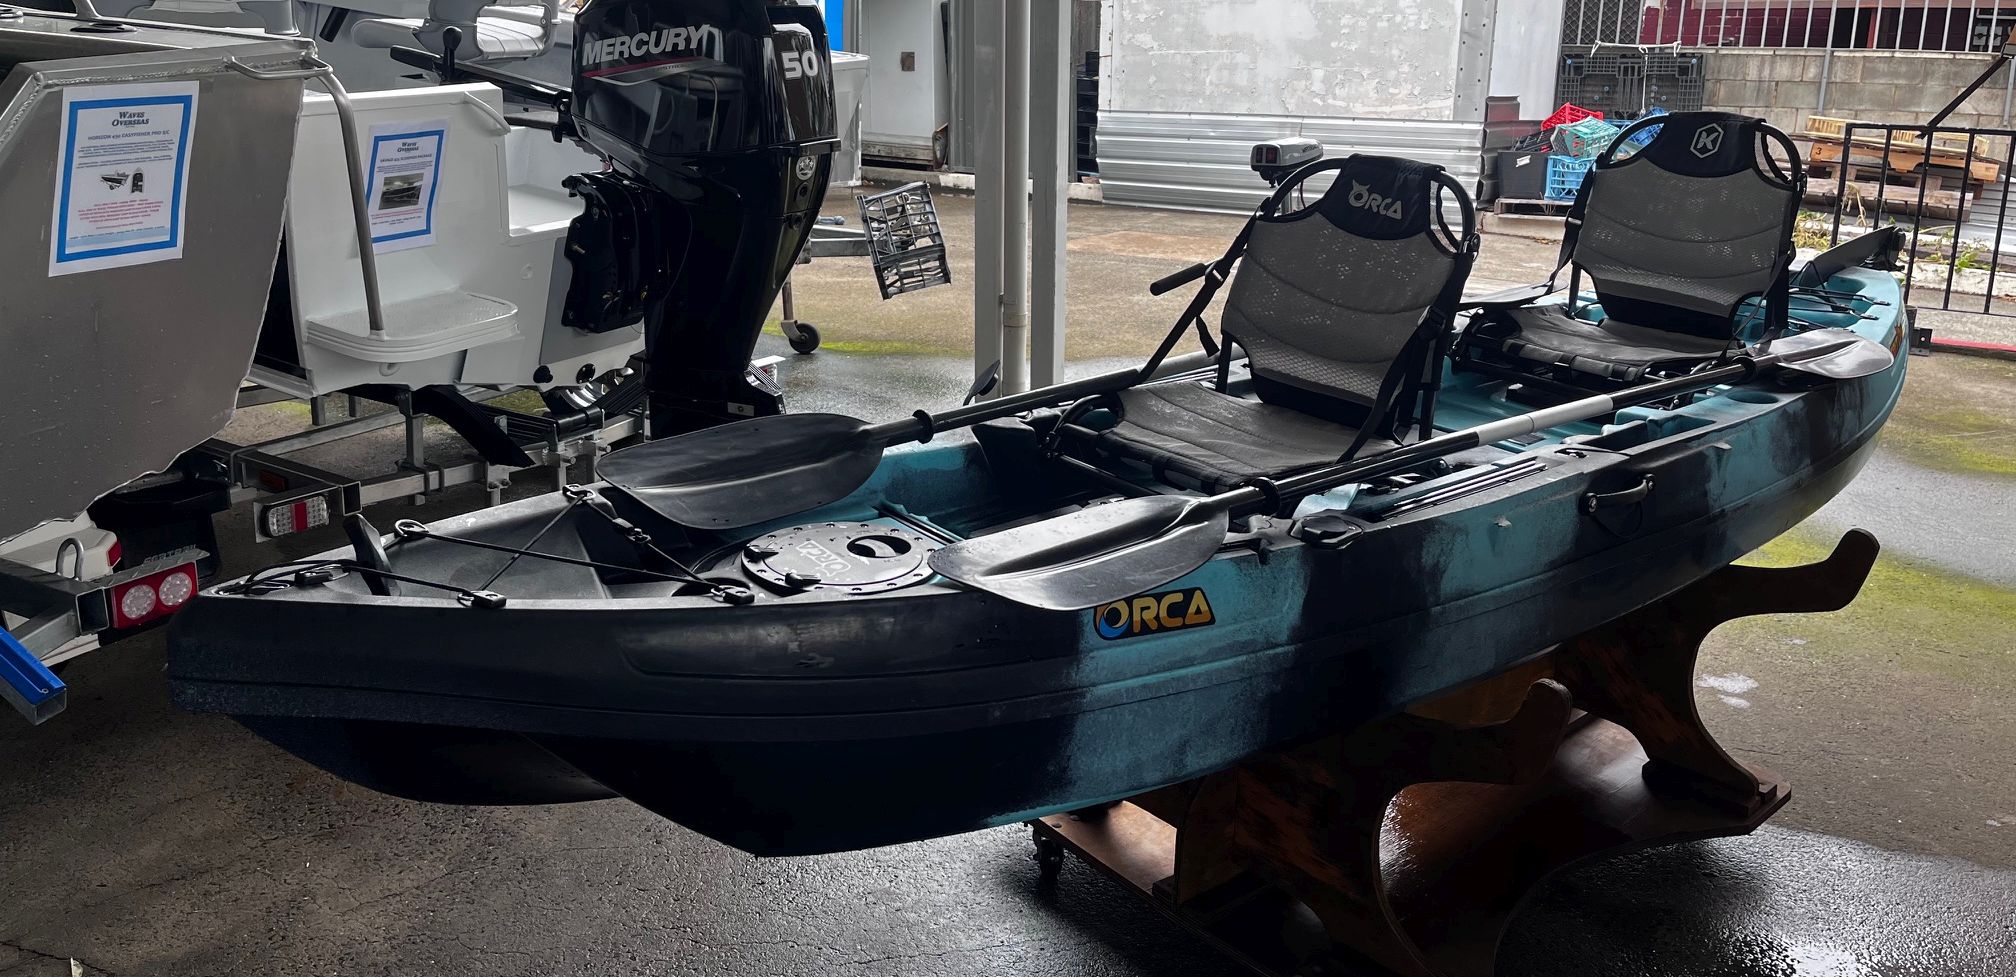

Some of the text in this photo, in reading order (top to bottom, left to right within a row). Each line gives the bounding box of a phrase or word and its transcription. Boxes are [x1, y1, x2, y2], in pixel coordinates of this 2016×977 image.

[582, 24, 710, 66] MERCURY
[782, 51, 819, 78] 50
[1815, 147, 1823, 155] 3
[1349, 180, 1402, 220] ORCA
[796, 540, 851, 577] ORCA
[1096, 590, 1212, 638] ORCA
